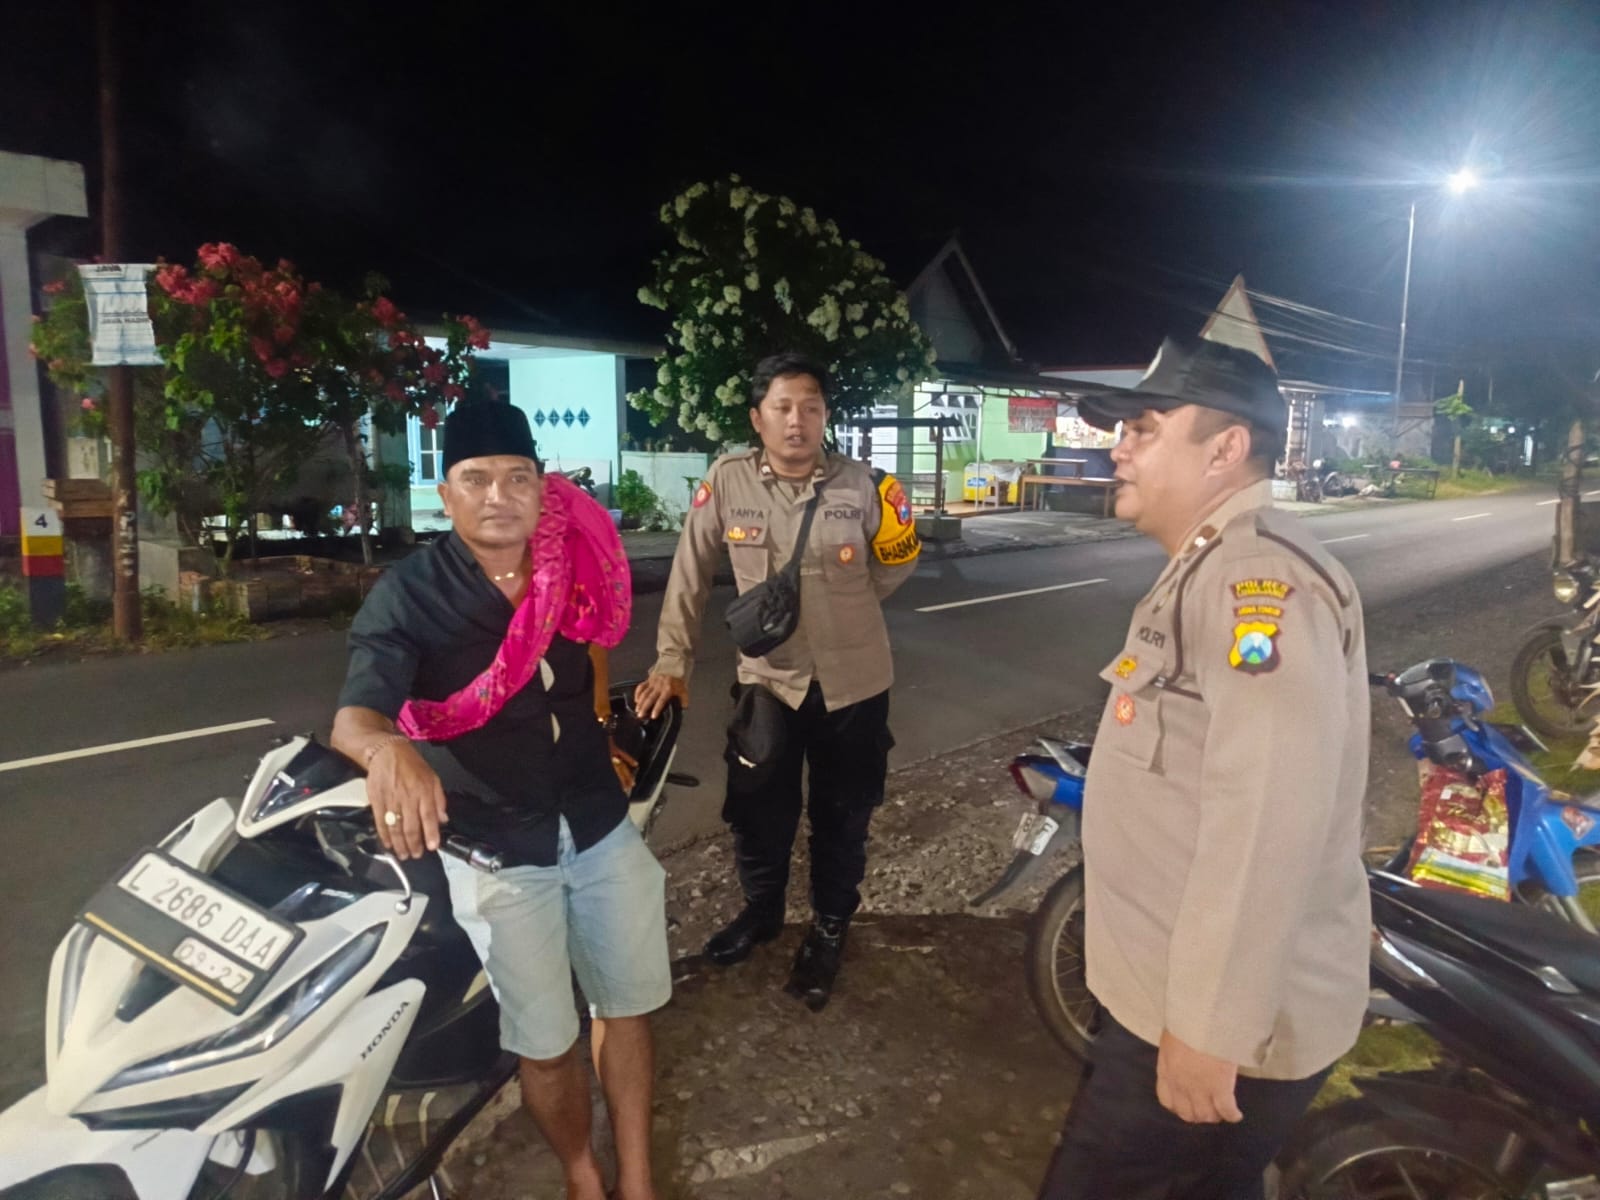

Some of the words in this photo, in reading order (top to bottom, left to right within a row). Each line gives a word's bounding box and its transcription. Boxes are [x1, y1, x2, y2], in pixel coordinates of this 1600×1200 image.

[35, 513, 48, 528] 4
[729, 508, 764, 519] YAHYA
[824, 509, 866, 521] POLRI
[128, 863, 150, 892] L
[152, 877, 223, 929] 2686
[220, 915, 278, 970] DAA
[360, 1001, 410, 1061] HONDA
